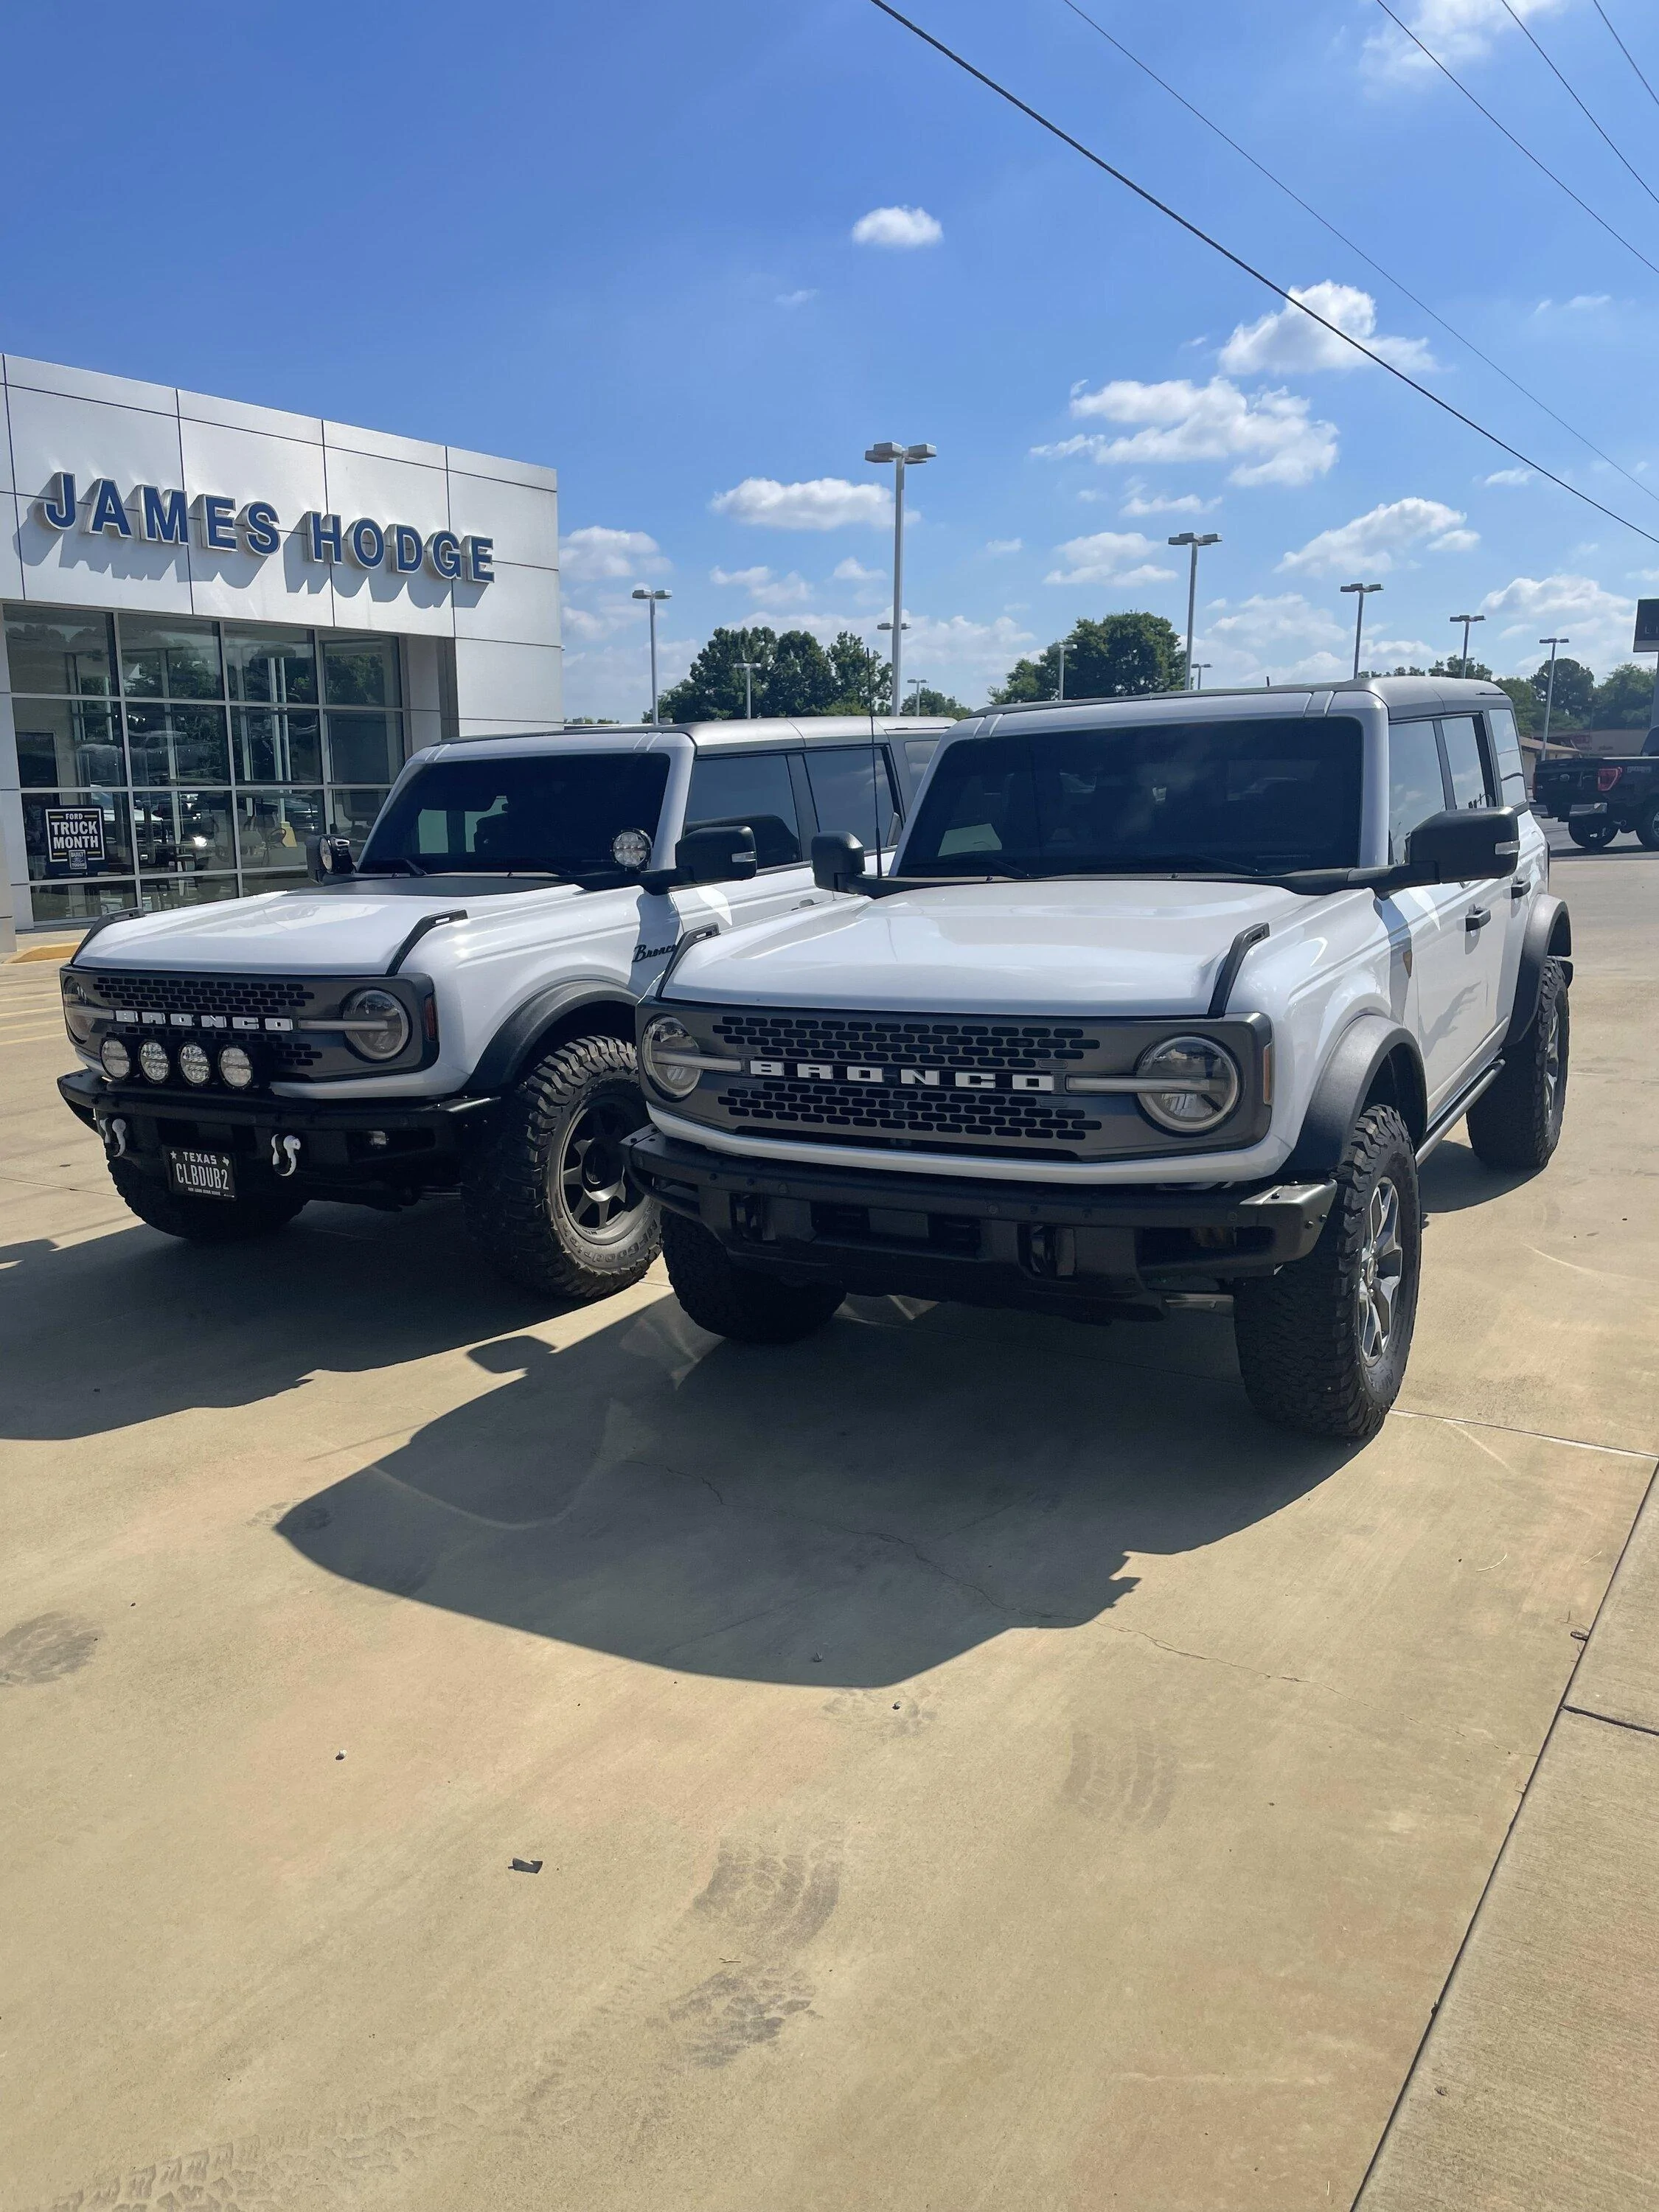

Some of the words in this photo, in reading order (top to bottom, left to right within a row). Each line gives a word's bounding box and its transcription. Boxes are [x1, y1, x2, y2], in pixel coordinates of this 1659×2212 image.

[44, 472, 280, 555] JAMES
[306, 511, 495, 583] HODGE
[51, 821, 98, 835] TRUCK
[53, 835, 99, 849] MONTH
[114, 1009, 293, 1031] BRONCO
[750, 1060, 1054, 1091] BRONCO
[182, 1152, 218, 1165] TEXAS
[175, 1163, 229, 1190] CLBDUB2
